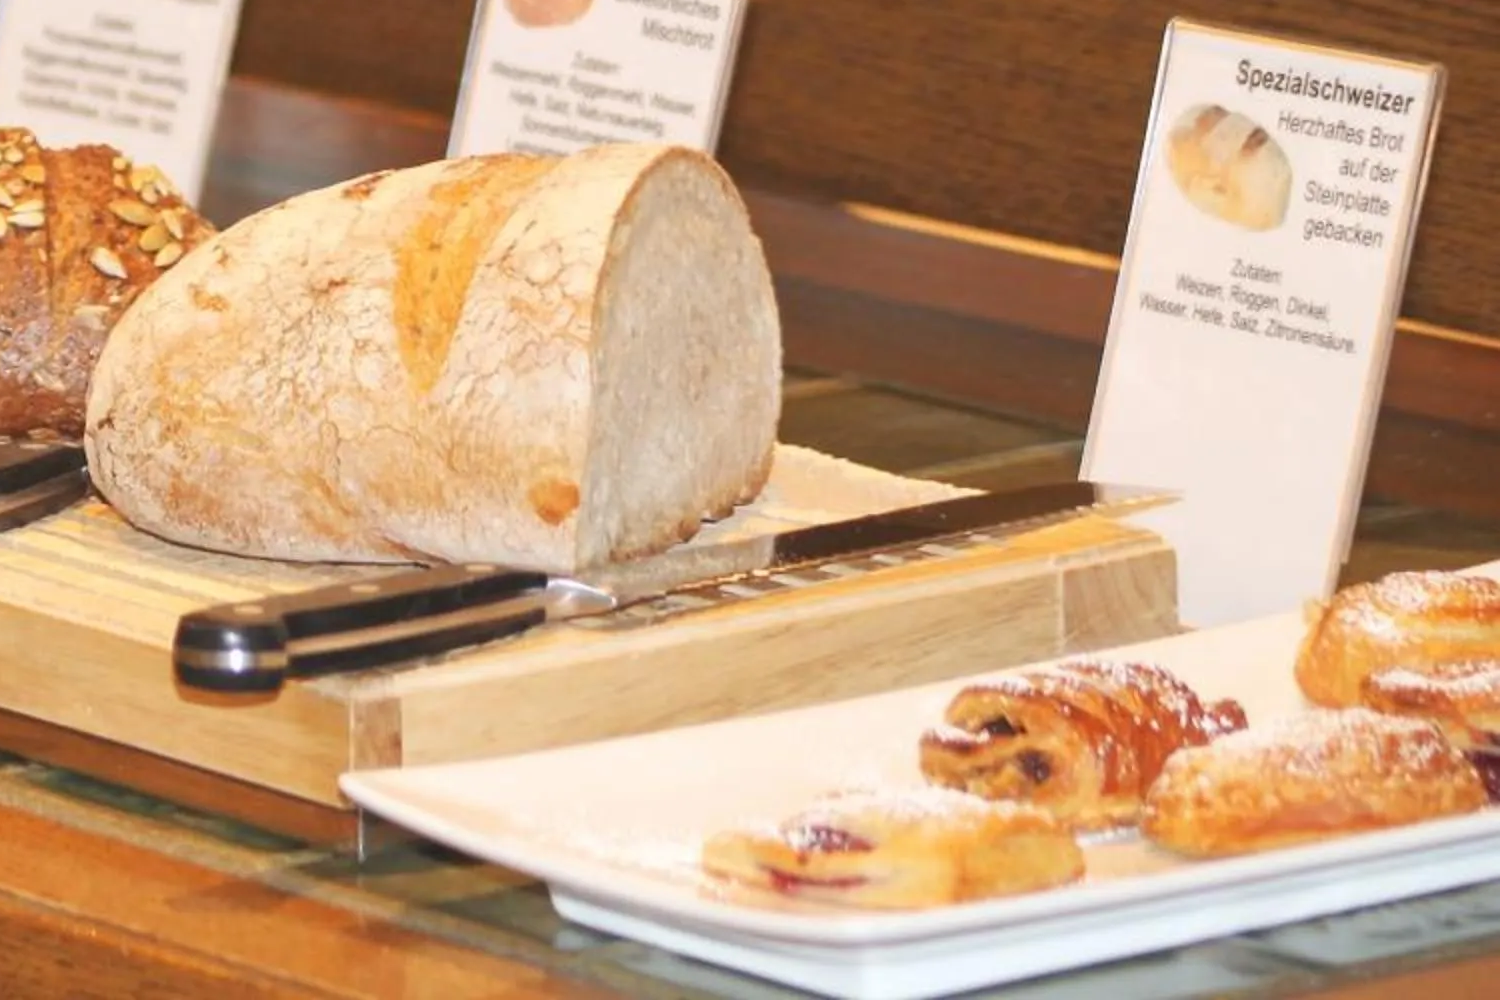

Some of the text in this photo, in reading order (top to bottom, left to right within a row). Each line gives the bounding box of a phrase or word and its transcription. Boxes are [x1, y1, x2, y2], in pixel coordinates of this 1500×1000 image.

[642, 16, 715, 51] Mischbrot
[1236, 59, 1414, 114] Spezialschweizer
[1278, 111, 1404, 152] Herzhaftes Brot
[1338, 158, 1398, 183] auf der
[1303, 180, 1392, 216] Steinplatte
[1303, 218, 1384, 248] gebacken
